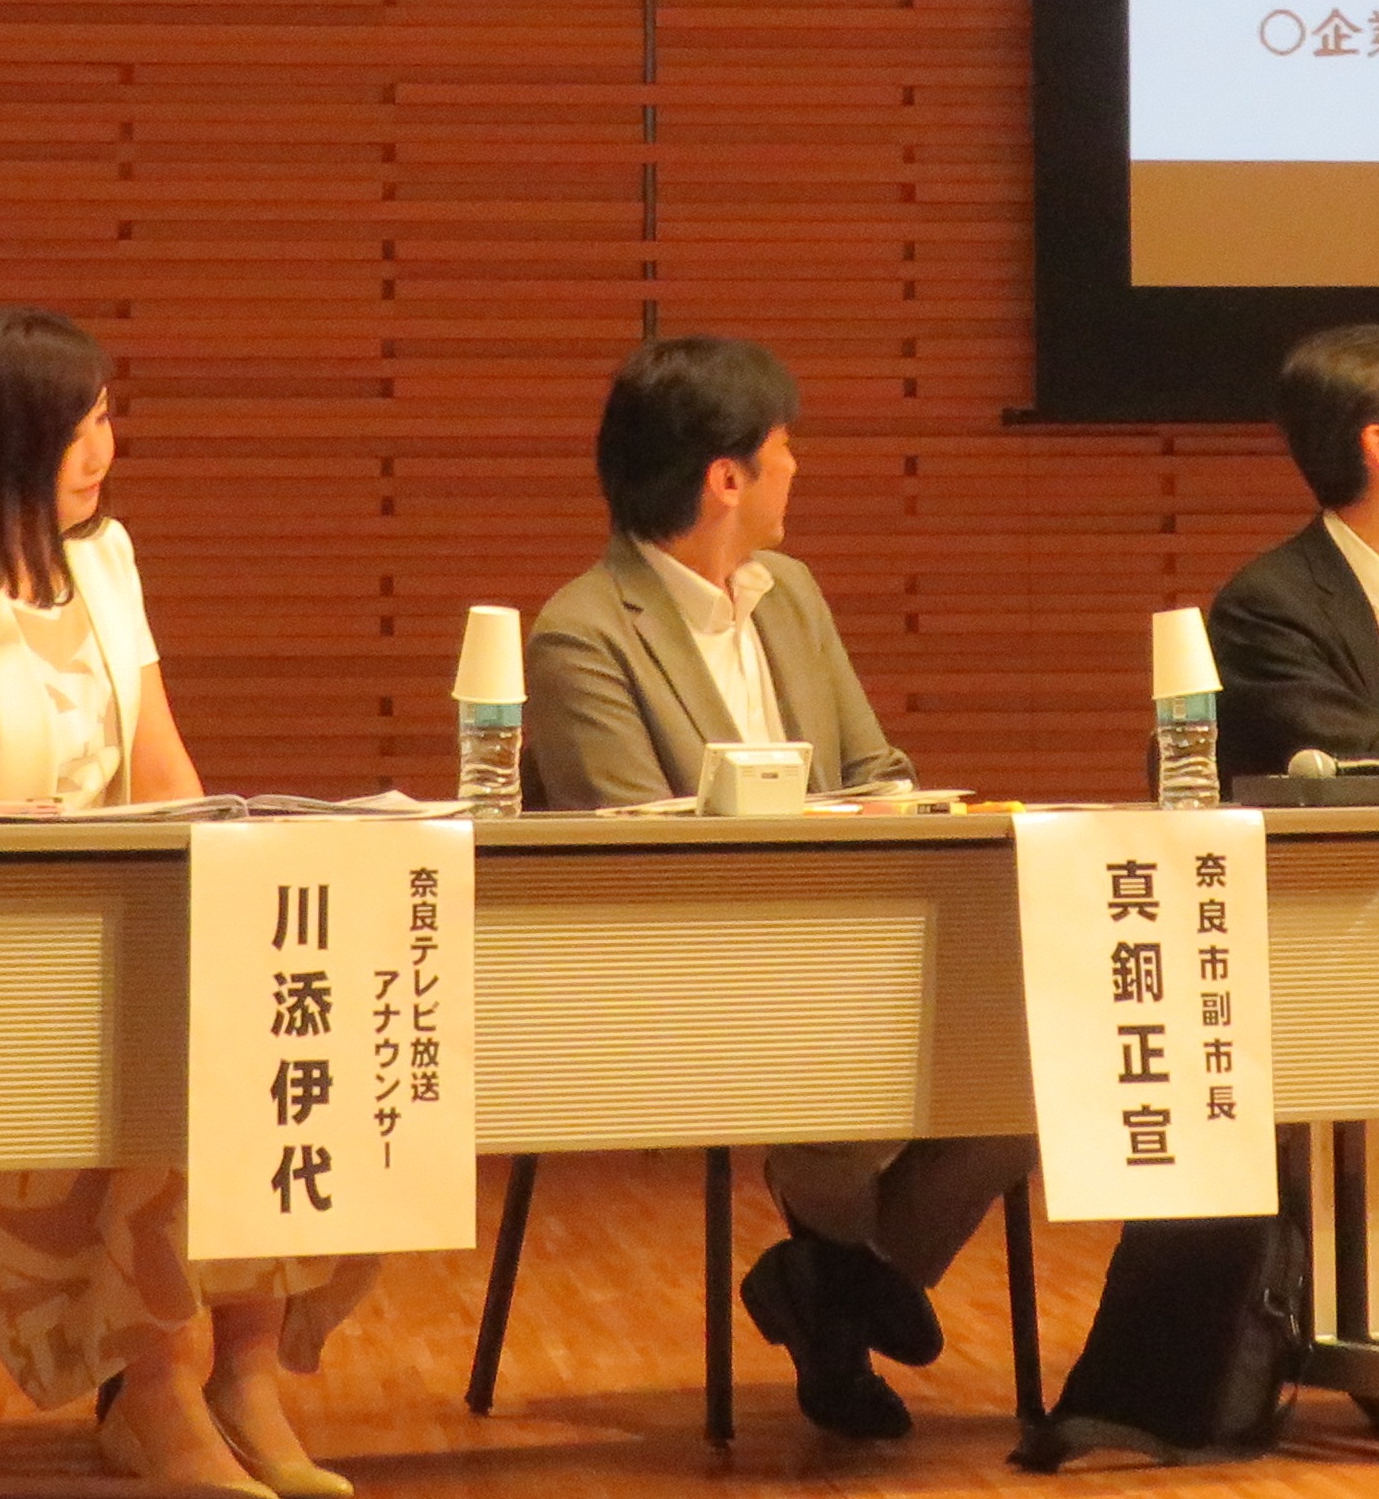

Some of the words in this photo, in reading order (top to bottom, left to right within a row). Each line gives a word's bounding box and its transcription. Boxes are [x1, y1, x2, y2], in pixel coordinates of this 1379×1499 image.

[270, 884, 333, 1214] 川添伊代
[372, 970, 402, 1169] アナウンサー
[409, 867, 440, 1103] 奈良テレビ放送
[1106, 859, 1176, 1167] 真銅正宣
[1195, 852, 1237, 1121] 奈良市副市長
